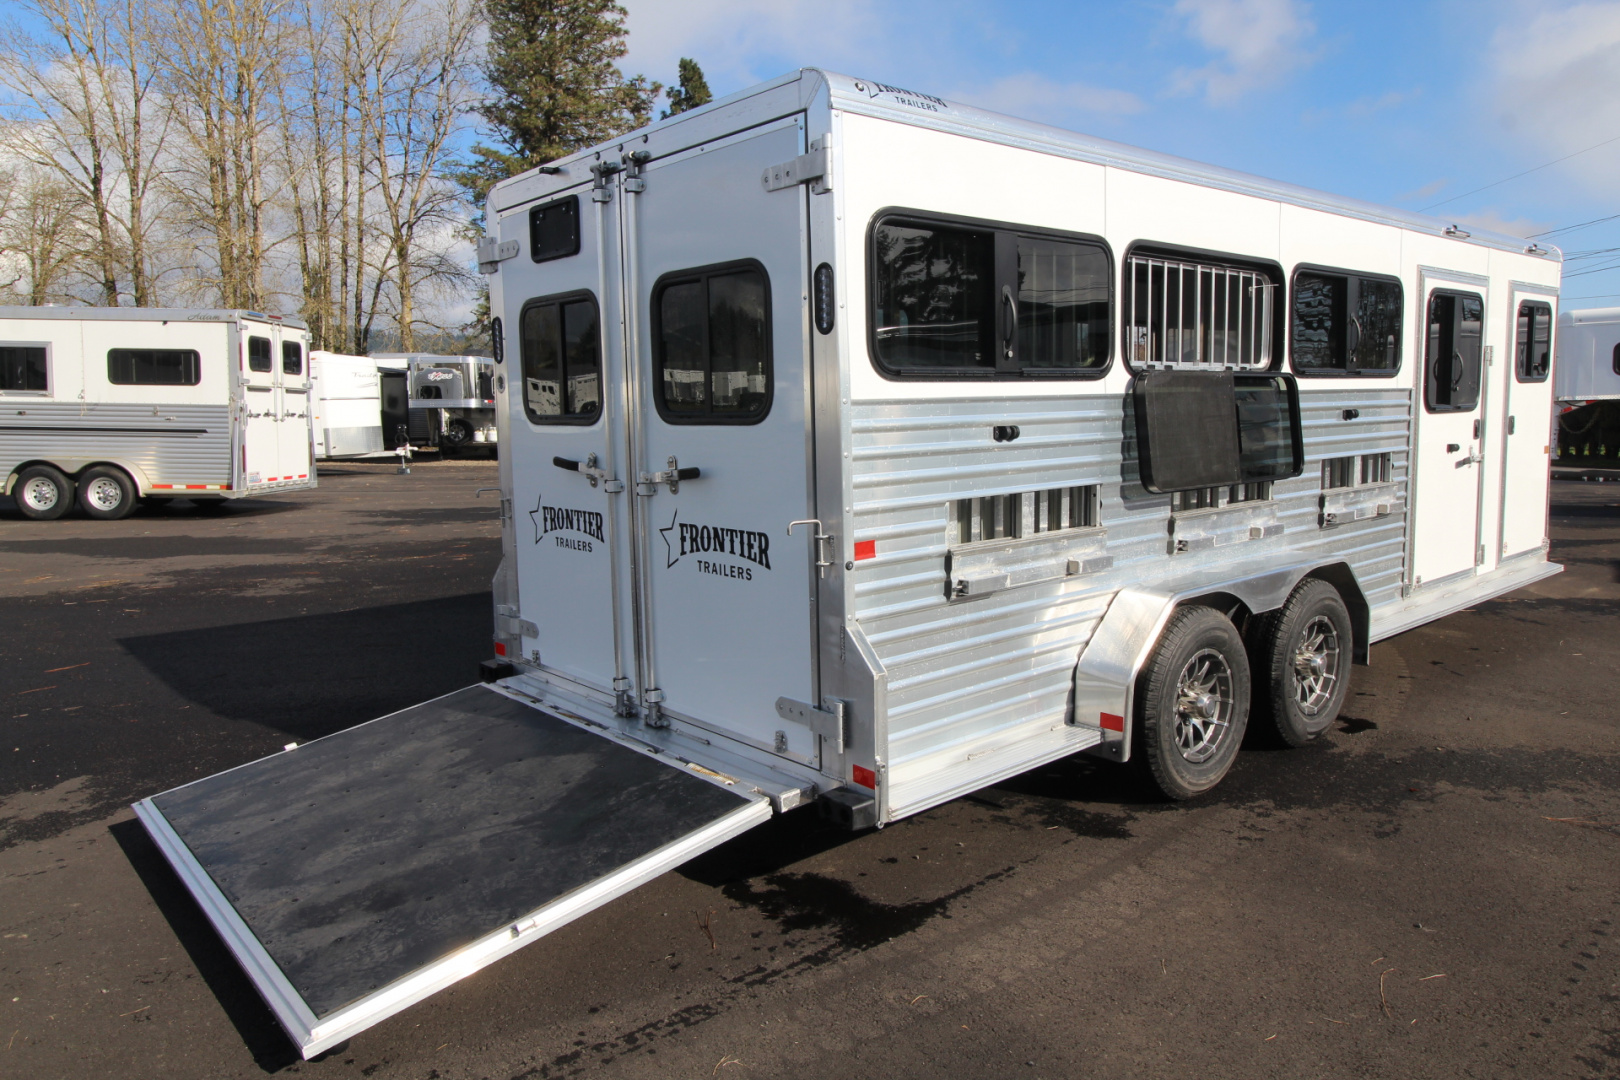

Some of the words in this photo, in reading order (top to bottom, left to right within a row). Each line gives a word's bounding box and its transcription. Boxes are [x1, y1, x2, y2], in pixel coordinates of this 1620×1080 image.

[895, 96, 938, 112] TRAILERS
[542, 506, 605, 543] FRONTIER
[555, 536, 593, 553] TRAILERS
[679, 523, 771, 570] FRONTIER
[697, 560, 752, 581] TRAILERS
